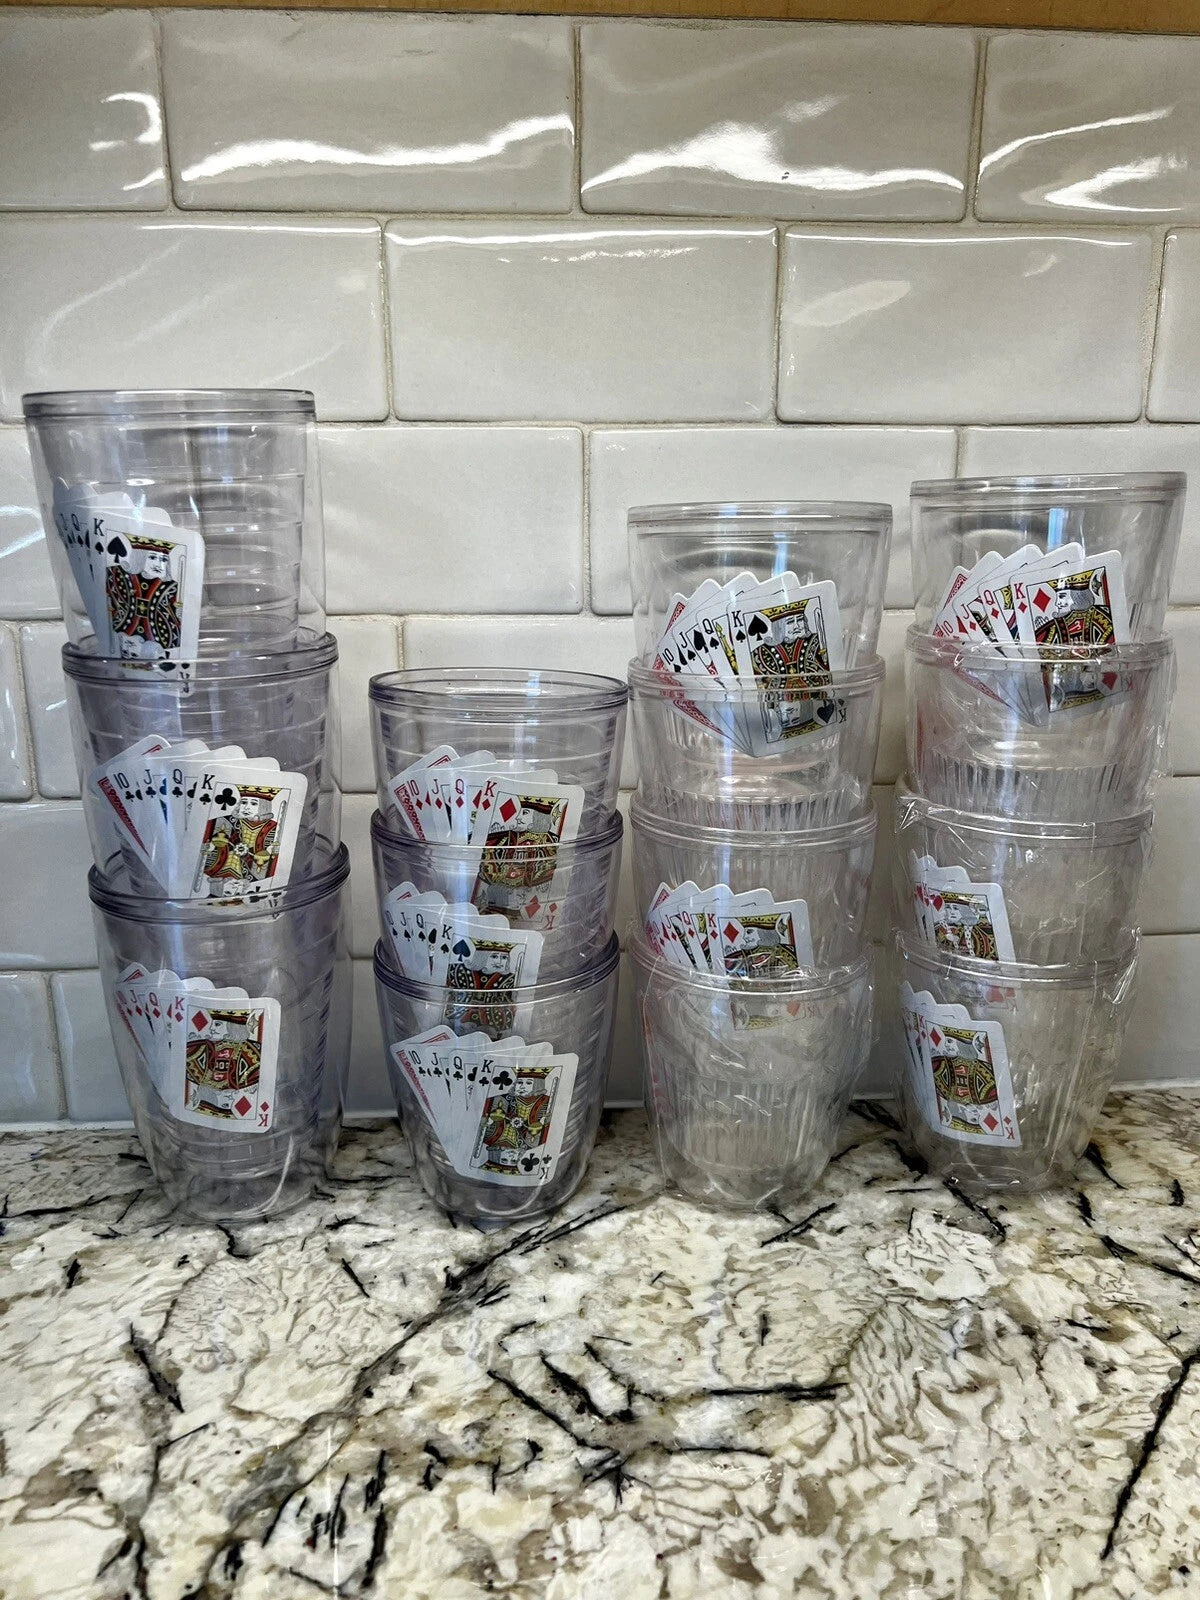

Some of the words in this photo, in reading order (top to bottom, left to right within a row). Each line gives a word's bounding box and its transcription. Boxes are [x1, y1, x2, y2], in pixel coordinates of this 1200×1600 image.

[93, 517, 105, 537] K
[940, 620, 954, 636] 10
[960, 603, 970, 620] J
[983, 589, 995, 606] Q
[1014, 582, 1026, 600] K
[662, 647, 675, 665] 10
[679, 631, 688, 649] J
[702, 618, 715, 635] Q
[731, 610, 744, 628] K
[838, 708, 848, 724] K
[113, 772, 130, 790] 10
[143, 769, 153, 785] J
[172, 768, 183, 785] Q
[201, 773, 216, 791] K
[406, 779, 420, 796] 10
[431, 778, 440, 795] J
[454, 778, 465, 795] Q
[484, 780, 498, 797] K
[400, 911, 407, 927] J
[416, 913, 425, 930] Q
[442, 924, 453, 940] K
[545, 915, 556, 930] K
[681, 910, 692, 926] Q
[707, 913, 718, 929] K
[129, 989, 138, 1004] J
[148, 991, 159, 1007] Q
[174, 996, 185, 1011] K
[408, 1050, 422, 1065] 10
[431, 1052, 439, 1066] J
[453, 1055, 463, 1070] Q
[481, 1059, 494, 1074] K
[258, 1113, 269, 1127] K
[1005, 1126, 1015, 1140] K
[538, 1167, 550, 1180] K
